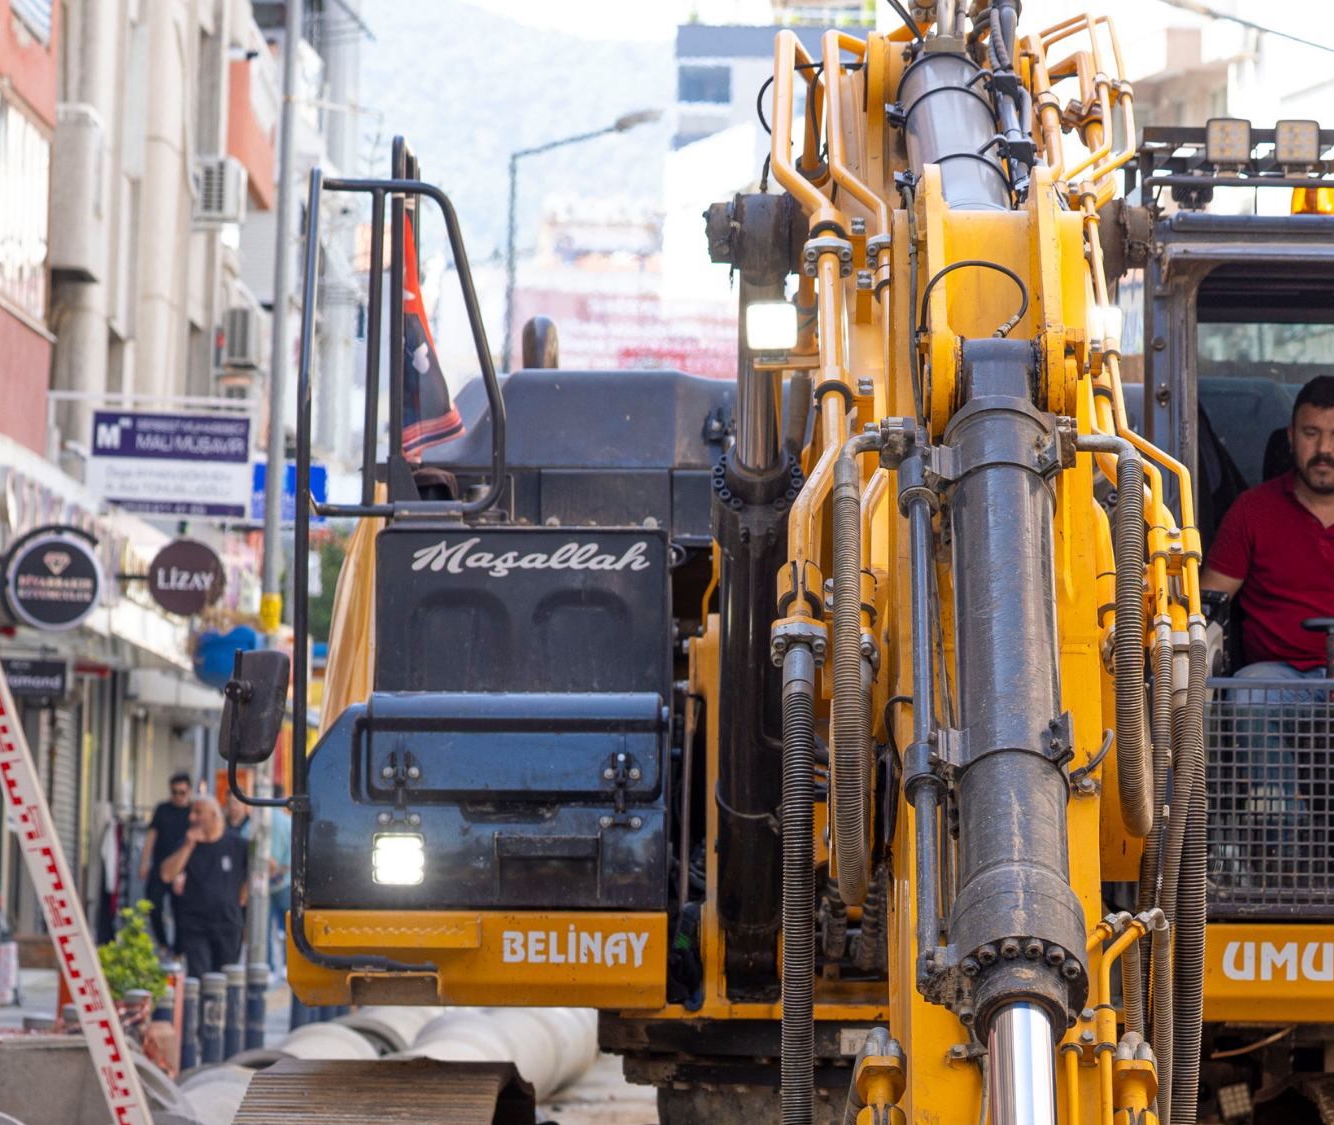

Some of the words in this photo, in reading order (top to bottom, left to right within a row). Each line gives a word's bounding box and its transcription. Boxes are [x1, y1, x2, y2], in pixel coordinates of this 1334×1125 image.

[411, 537, 651, 577] Maşallah
[157, 565, 215, 591] LİZAY
[502, 923, 649, 968] BELİNAY
